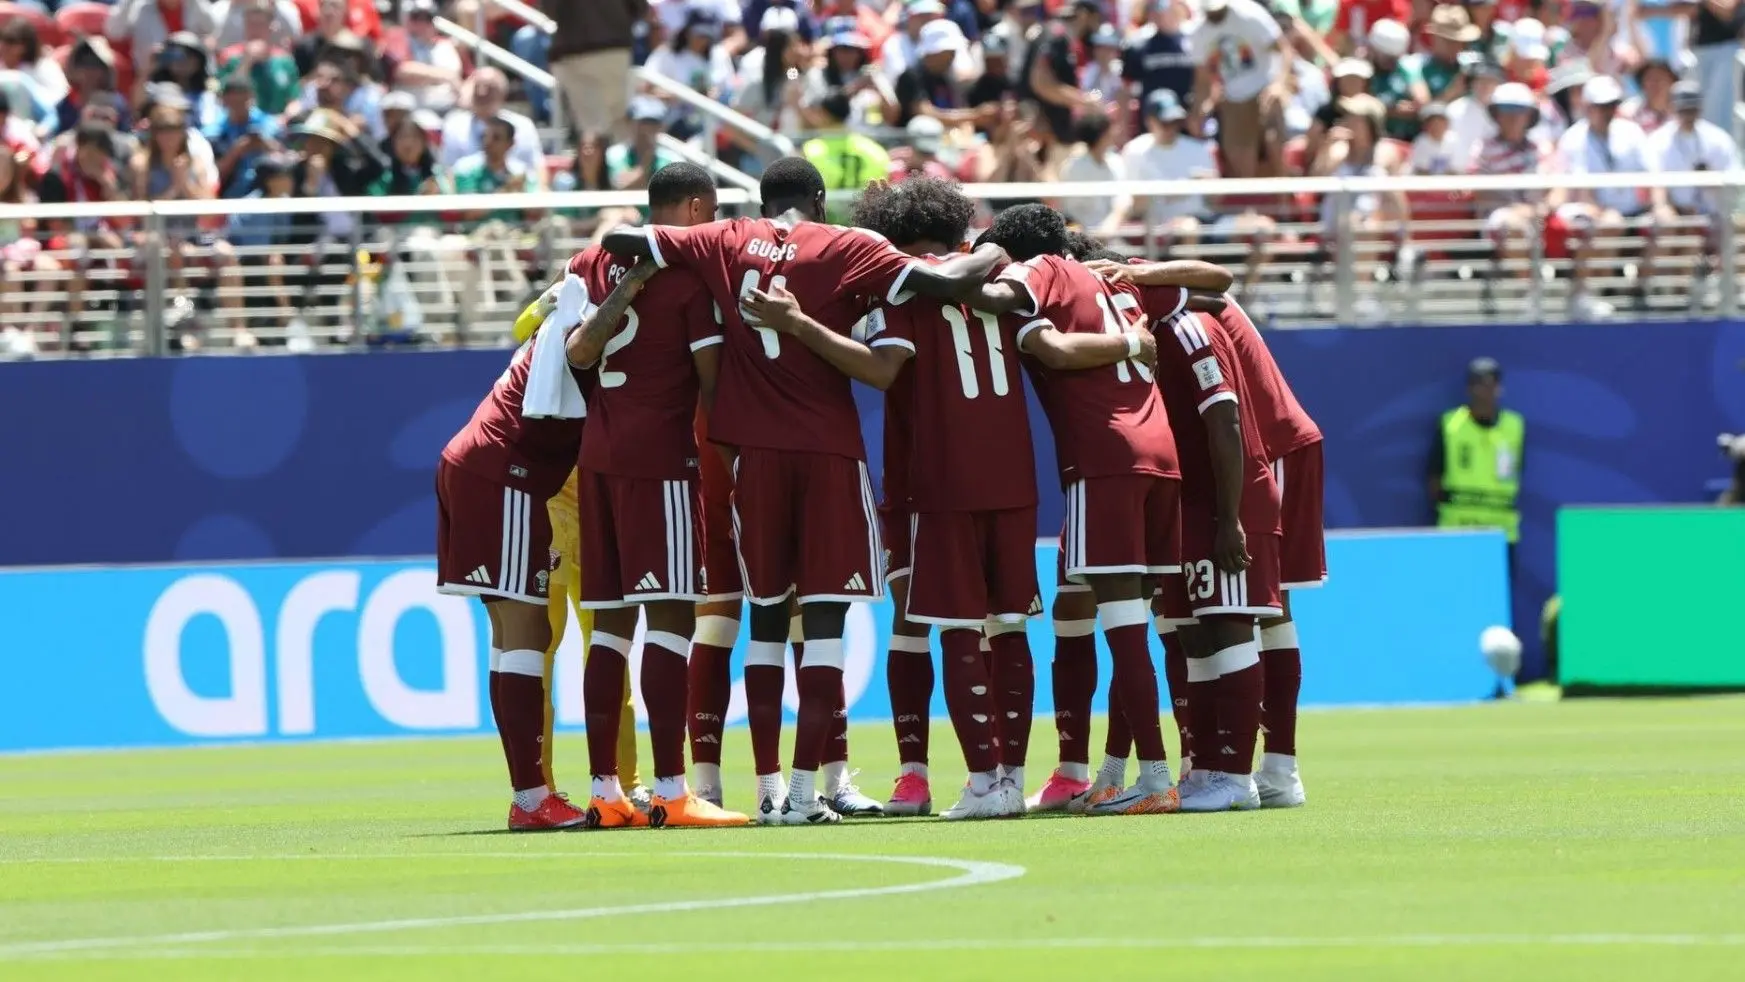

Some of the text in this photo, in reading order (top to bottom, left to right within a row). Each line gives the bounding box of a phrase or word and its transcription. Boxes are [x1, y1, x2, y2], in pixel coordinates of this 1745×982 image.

[598, 304, 640, 388] 2
[941, 303, 1009, 400] 11
[1184, 558, 1215, 602] 23
[143, 570, 876, 735] ara
[695, 711, 721, 724] QFA
[898, 713, 921, 723] QFA
